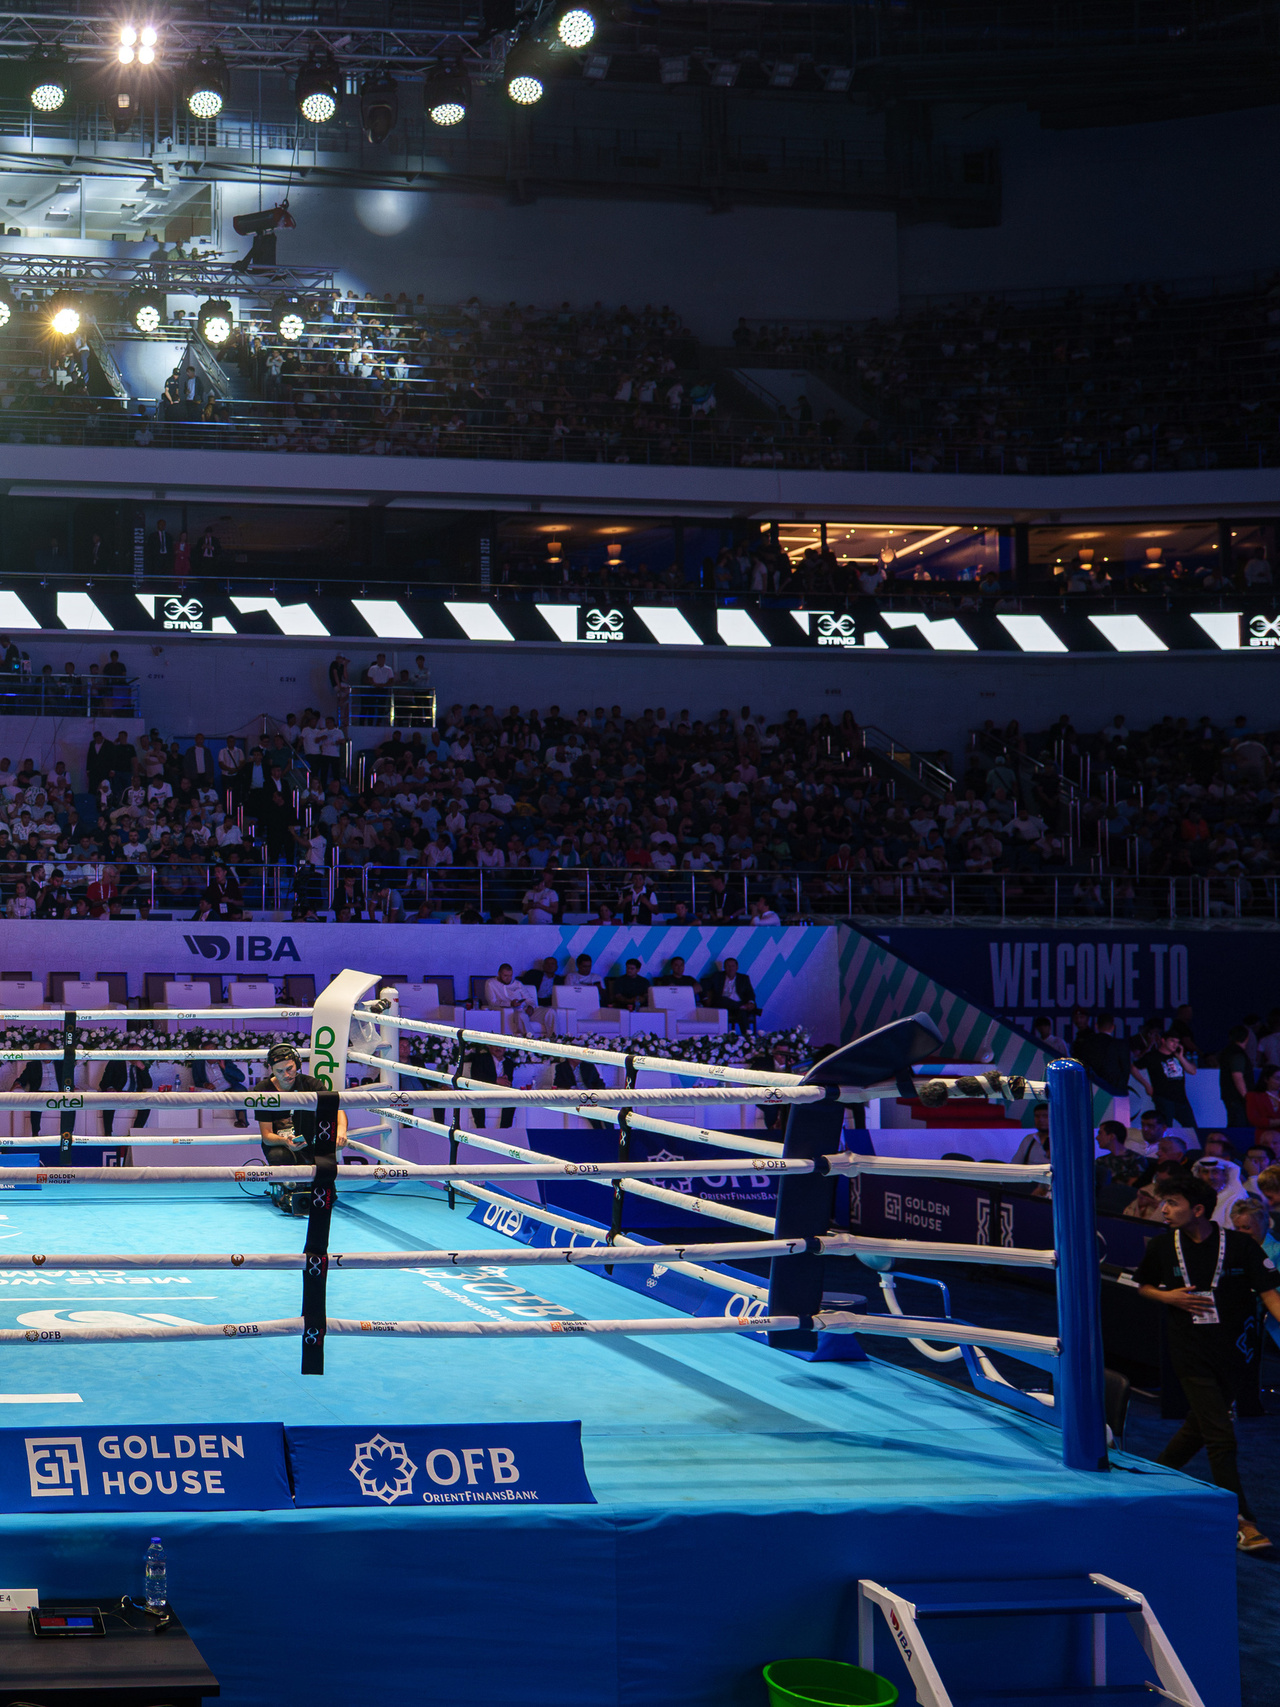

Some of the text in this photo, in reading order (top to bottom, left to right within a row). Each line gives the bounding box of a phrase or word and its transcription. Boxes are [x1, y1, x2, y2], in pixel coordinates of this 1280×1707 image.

[162, 621, 203, 630] STING
[586, 632, 624, 640] STING
[818, 637, 856, 646] STING
[236, 935, 301, 961] IBA
[990, 942, 1190, 1010] WELCOME TO
[46, 1094, 84, 1109] artel
[244, 1093, 281, 1108] artel
[579, 1164, 599, 1173] OFB
[766, 1160, 787, 1169] OFB
[388, 1169, 409, 1178] OFB
[904, 1196, 951, 1217] GOLDEN
[904, 1212, 943, 1232] HOUSE
[40, 1331, 61, 1340] OFB
[238, 1325, 259, 1334] OFB
[98, 1435, 245, 1460] GOLDEN
[426, 1447, 520, 1486] OFB
[102, 1469, 226, 1496] HOUSE
[6, 1594, 11, 1603] 4
[897, 1630, 913, 1662] IBA
